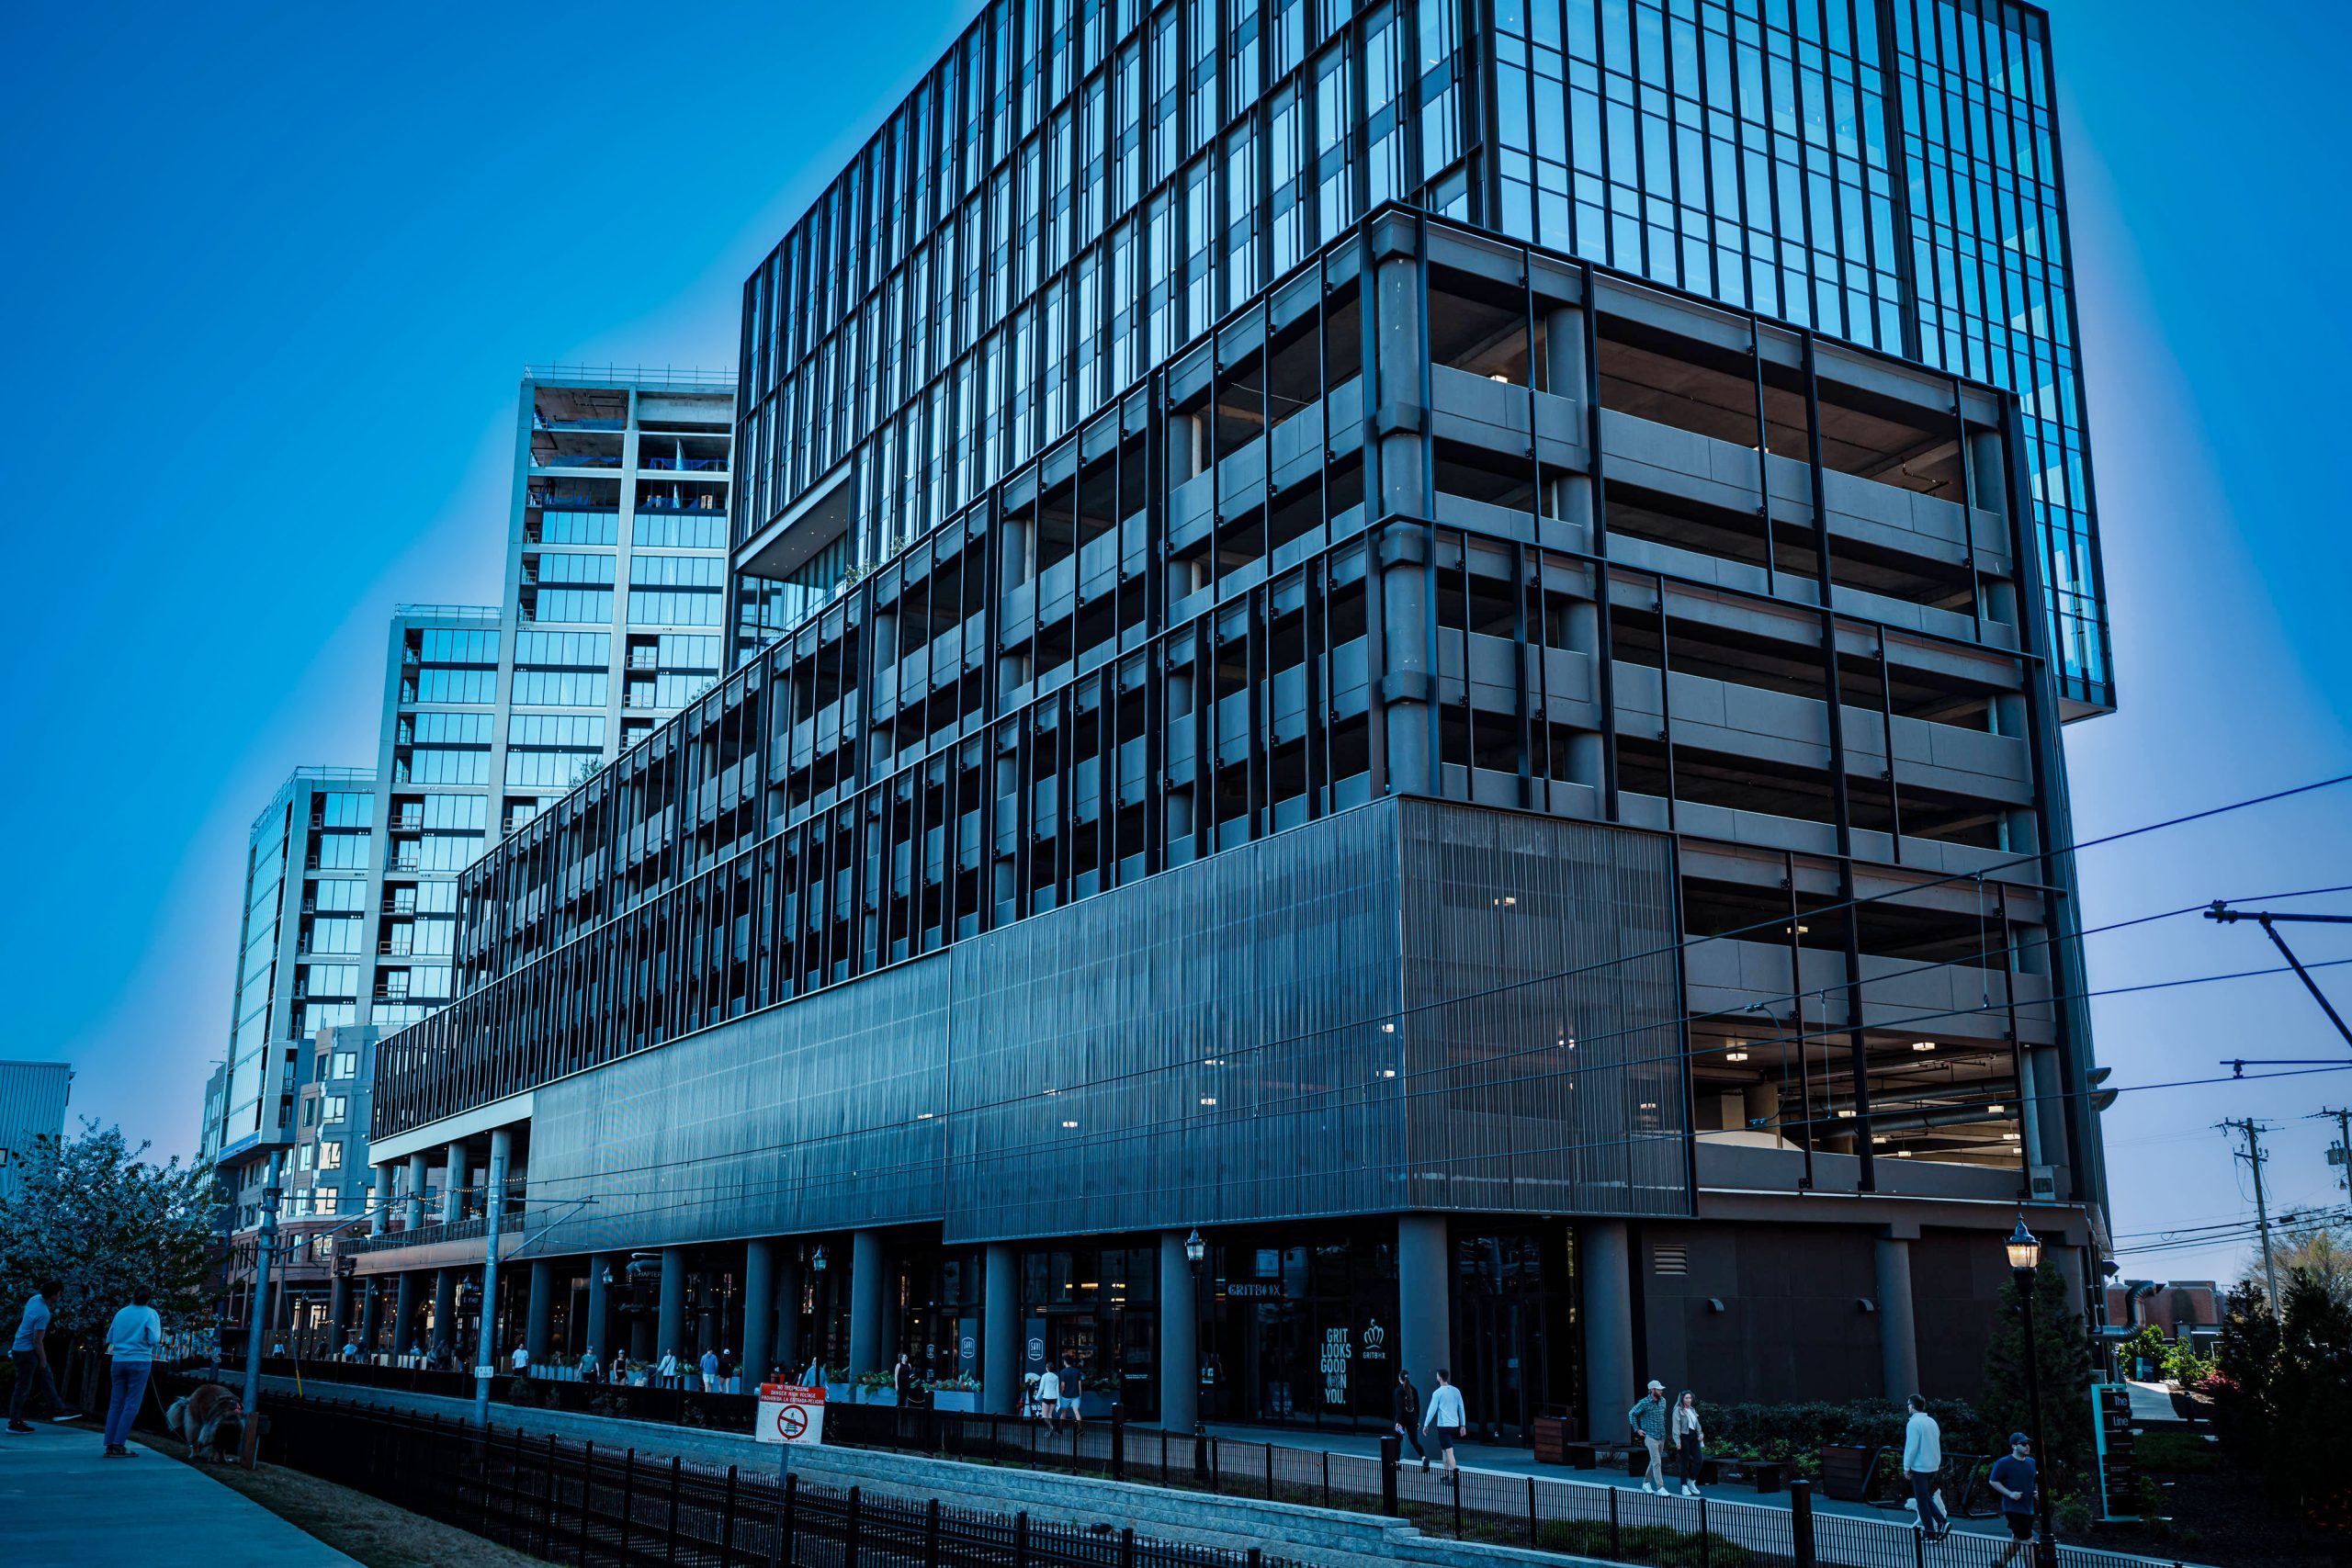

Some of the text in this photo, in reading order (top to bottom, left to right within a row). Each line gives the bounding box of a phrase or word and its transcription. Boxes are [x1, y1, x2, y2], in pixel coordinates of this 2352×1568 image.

[1327, 1328, 1348, 1343] GRIT
[1321, 1343, 1351, 1358] LOOKS
[1320, 1359, 1346, 1373] GOOD
[1325, 1389, 1346, 1404] YOU.
[2114, 1396, 2128, 1405] The
[2113, 1416, 2129, 1426] Line
